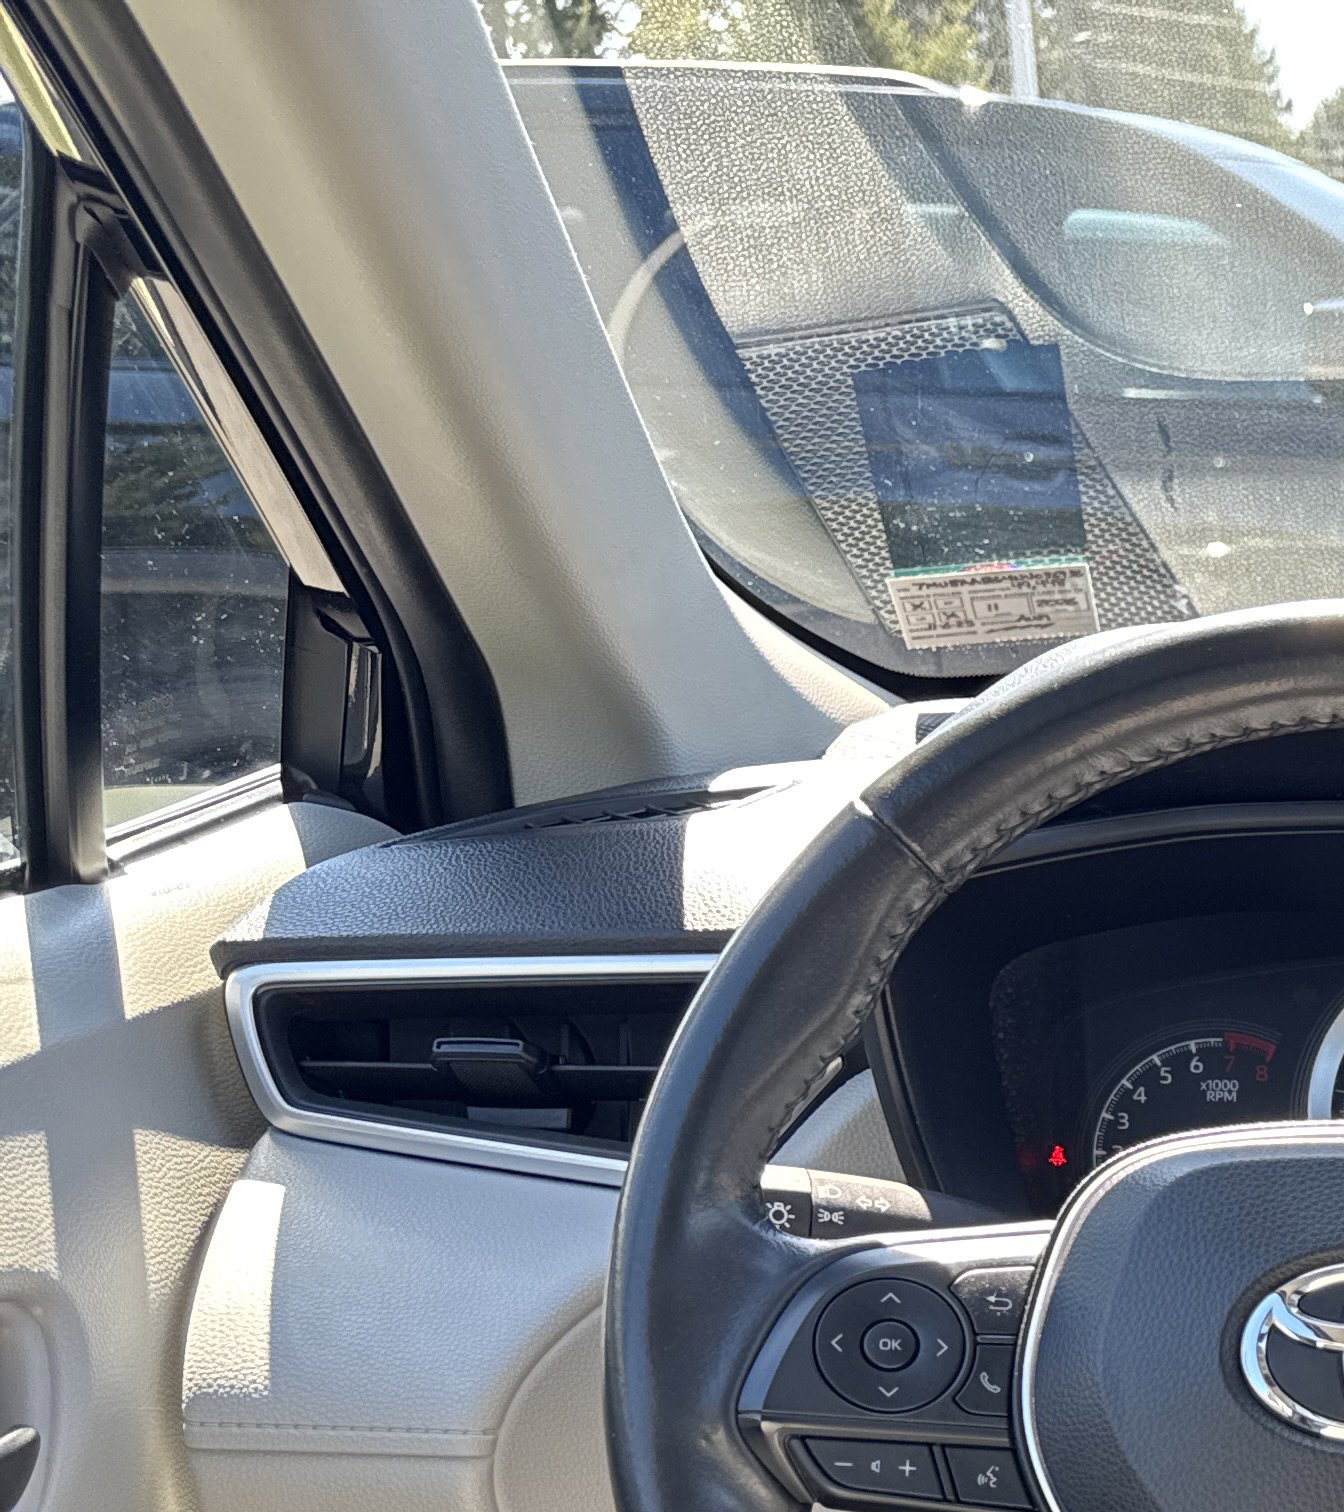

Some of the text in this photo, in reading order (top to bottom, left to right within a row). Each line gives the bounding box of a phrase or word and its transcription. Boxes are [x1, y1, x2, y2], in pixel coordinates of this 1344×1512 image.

[1189, 1056, 1204, 1074] 6
[1224, 1055, 1236, 1072] 7
[1159, 1067, 1173, 1085] 5
[1255, 1065, 1269, 1081] 8
[1200, 1079, 1239, 1091] x1000
[1132, 1086, 1147, 1104] 4
[1206, 1091, 1237, 1103] RPM
[1117, 1112, 1130, 1130] 3
[878, 1338, 902, 1351] OK
